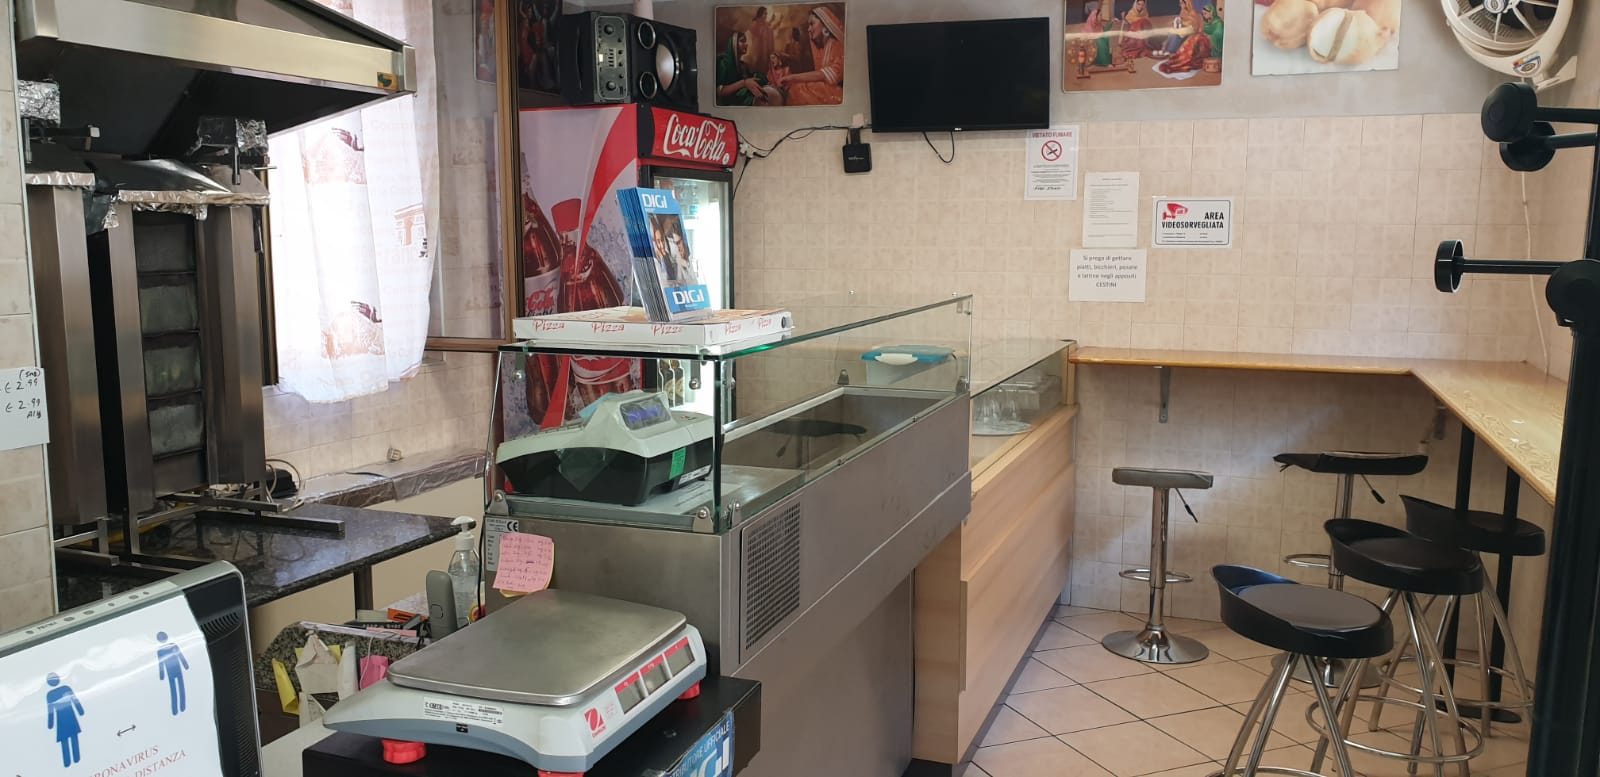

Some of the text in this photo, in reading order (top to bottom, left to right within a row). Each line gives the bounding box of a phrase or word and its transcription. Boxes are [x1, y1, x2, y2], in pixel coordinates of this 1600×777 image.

[642, 193, 668, 209] DIGI
[1204, 211, 1224, 220] AREA
[1161, 221, 1224, 229] VIDEOSORVEGLIATA
[672, 288, 705, 305] DIGI
[533, 320, 566, 333] Pizza
[591, 321, 625, 334] Pizza
